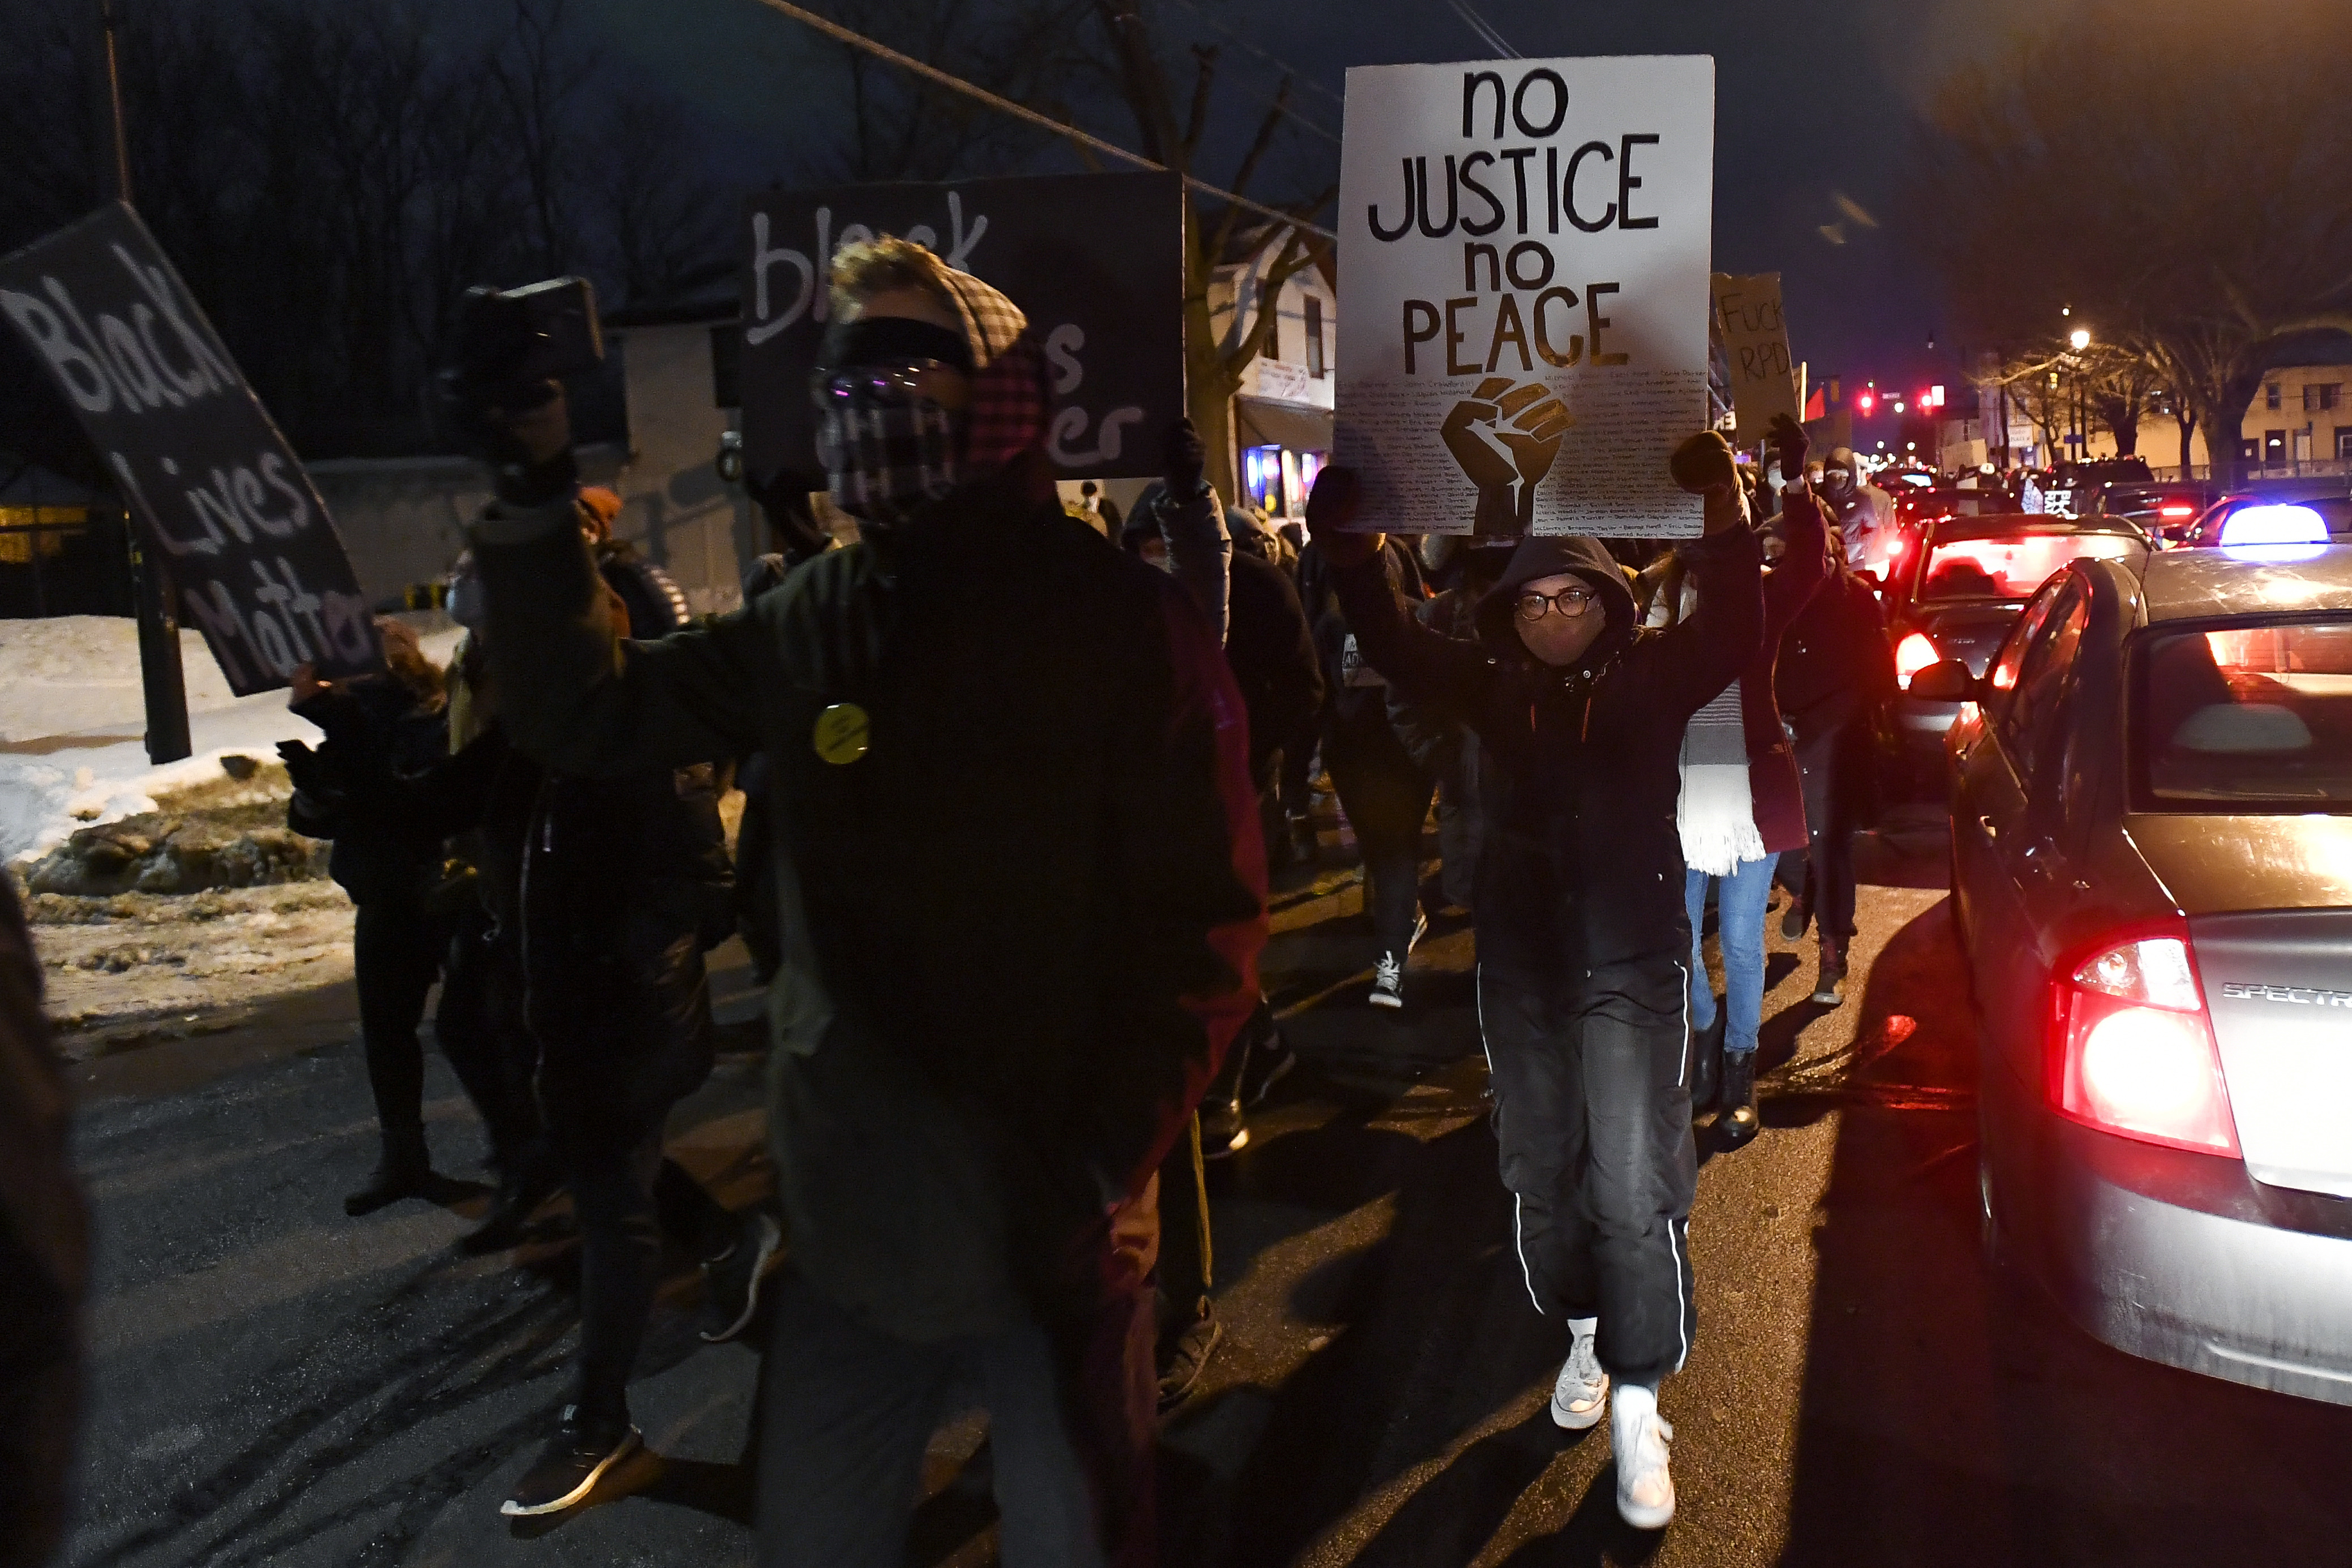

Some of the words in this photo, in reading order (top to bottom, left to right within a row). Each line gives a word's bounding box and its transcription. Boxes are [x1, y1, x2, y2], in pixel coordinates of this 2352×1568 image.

[1368, 133, 1660, 242] JUSTICE
[1464, 239, 1556, 292] no
[1720, 293, 1782, 332] FUCK
[0, 243, 235, 414] Black
[1402, 282, 1629, 377] PEACE
[1740, 341, 1790, 381] RPD
[110, 452, 310, 555] Lives
